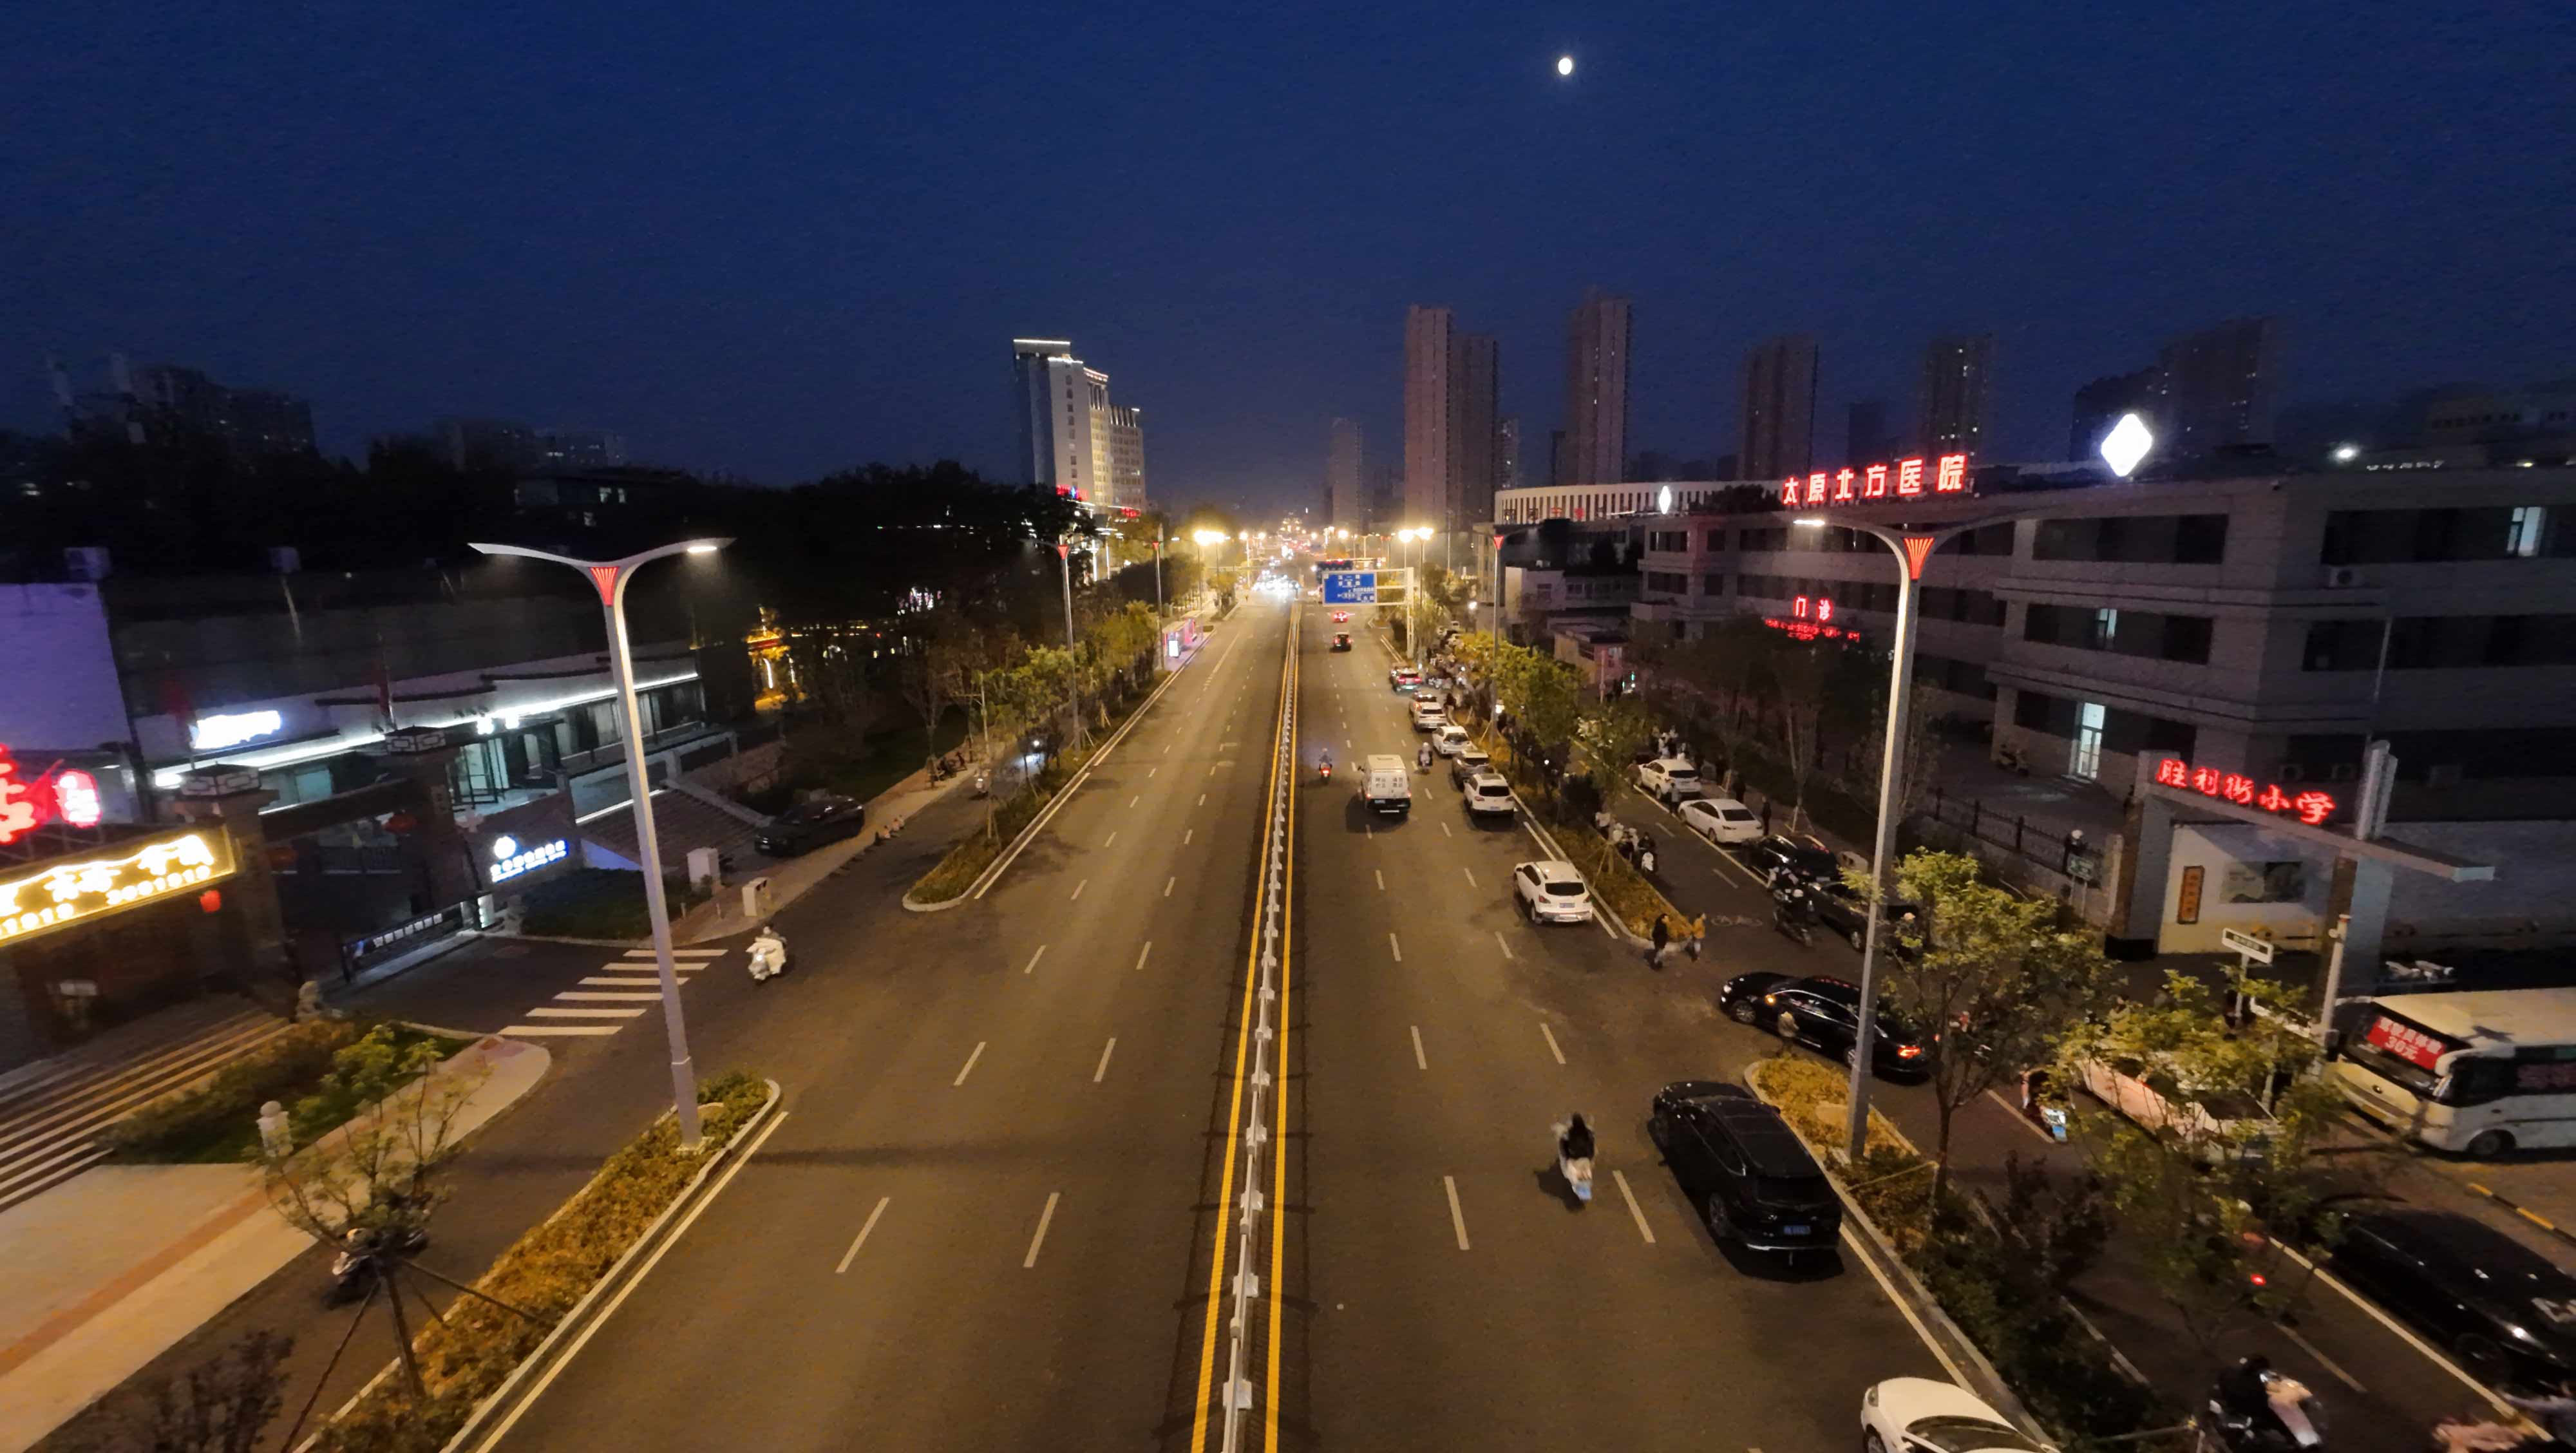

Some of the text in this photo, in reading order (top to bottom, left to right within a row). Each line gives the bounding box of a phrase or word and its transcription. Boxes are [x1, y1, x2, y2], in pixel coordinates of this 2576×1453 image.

[1783, 453, 1967, 506] 太原北方医院
[2156, 758, 2336, 825] 胜利街小学
[2384, 1036, 2419, 1060] 30元
